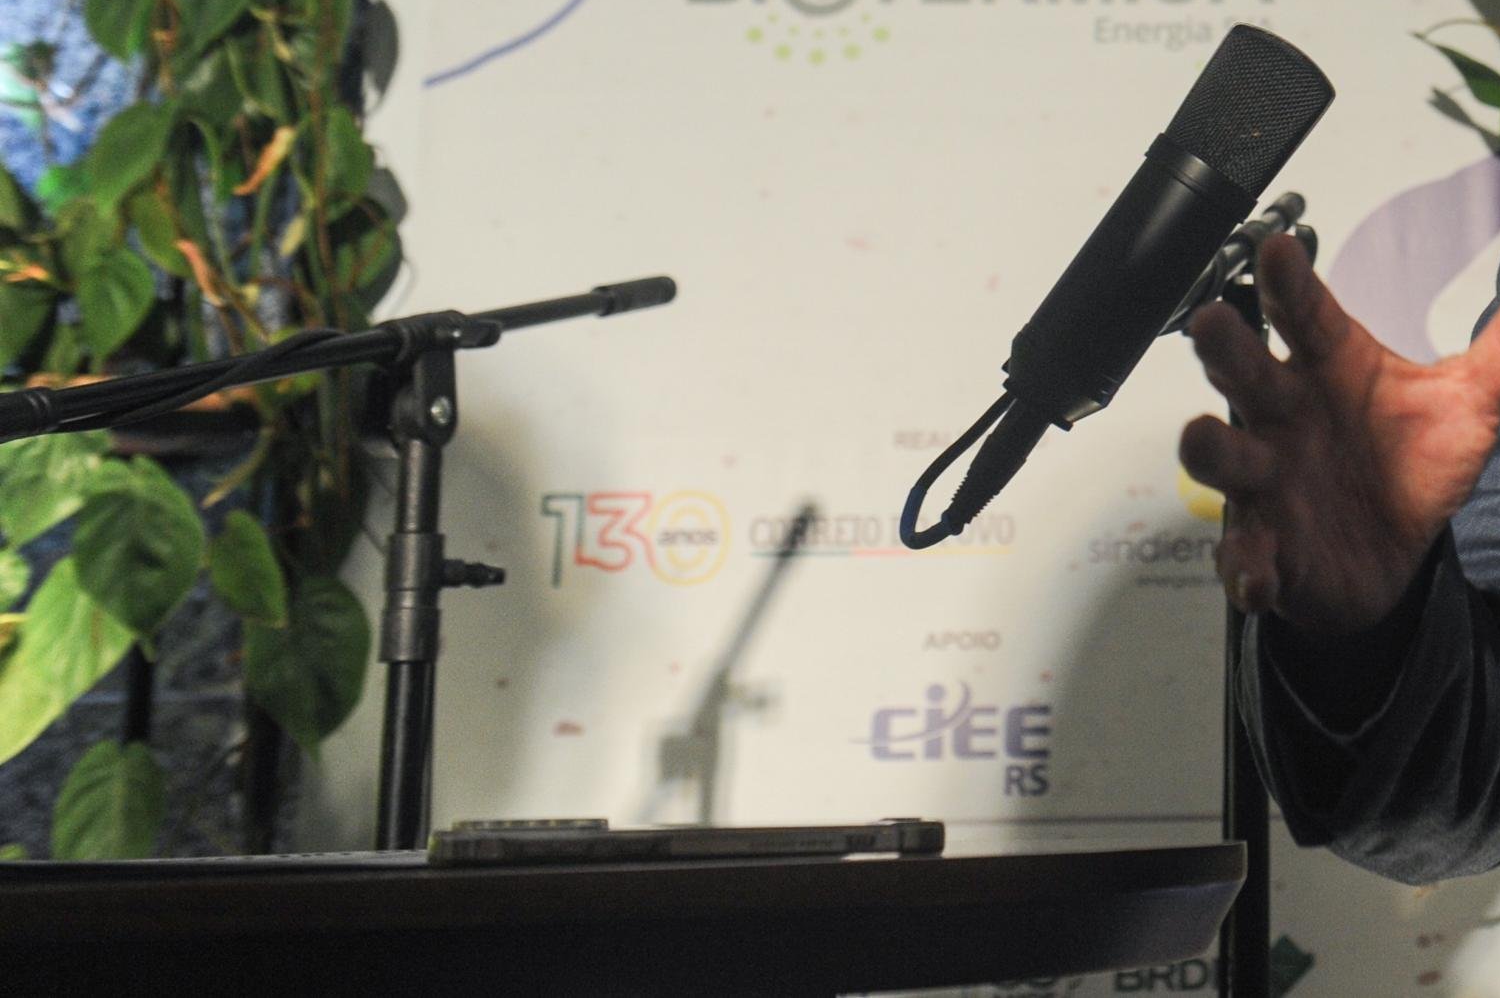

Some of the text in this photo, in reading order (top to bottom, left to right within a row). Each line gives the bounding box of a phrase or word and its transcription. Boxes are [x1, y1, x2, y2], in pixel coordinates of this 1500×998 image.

[1093, 16, 1212, 51] Energia
[656, 528, 718, 548] anos
[1088, 527, 1220, 564] sindien
[923, 630, 1001, 652] APOIO
[1005, 765, 1051, 797] RS
[1114, 958, 1219, 993] BRD
